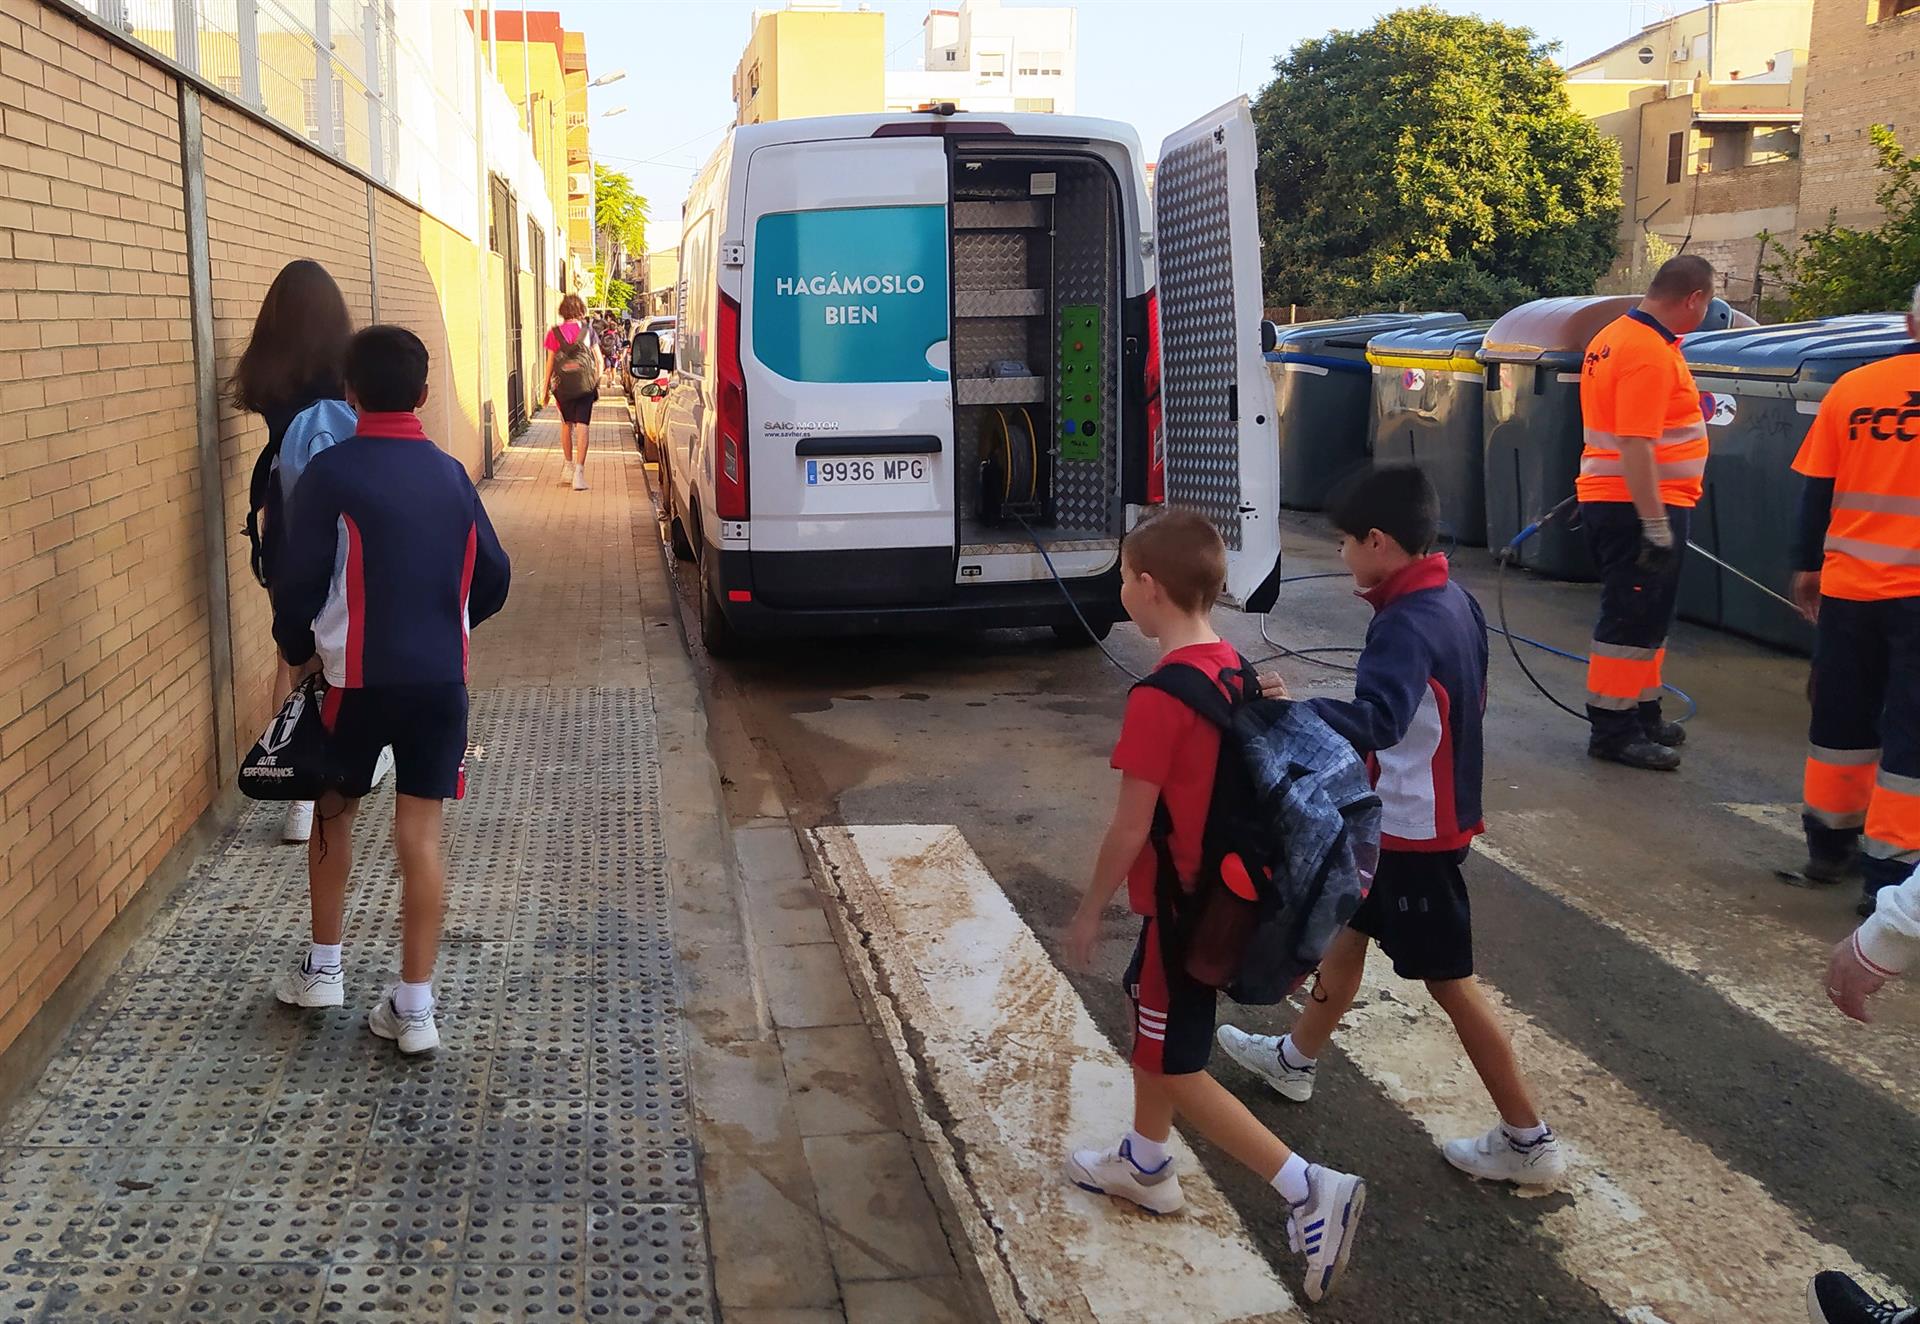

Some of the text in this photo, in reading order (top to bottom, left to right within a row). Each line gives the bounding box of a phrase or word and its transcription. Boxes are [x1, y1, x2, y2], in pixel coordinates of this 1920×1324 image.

[776, 271, 925, 296] HAGÁMOSLO
[825, 305, 878, 325] BIEN
[764, 420, 839, 431] SAIC MOTOR
[1849, 406, 1920, 442] FCC
[822, 461, 875, 482] 9936
[884, 459, 923, 480] MPG
